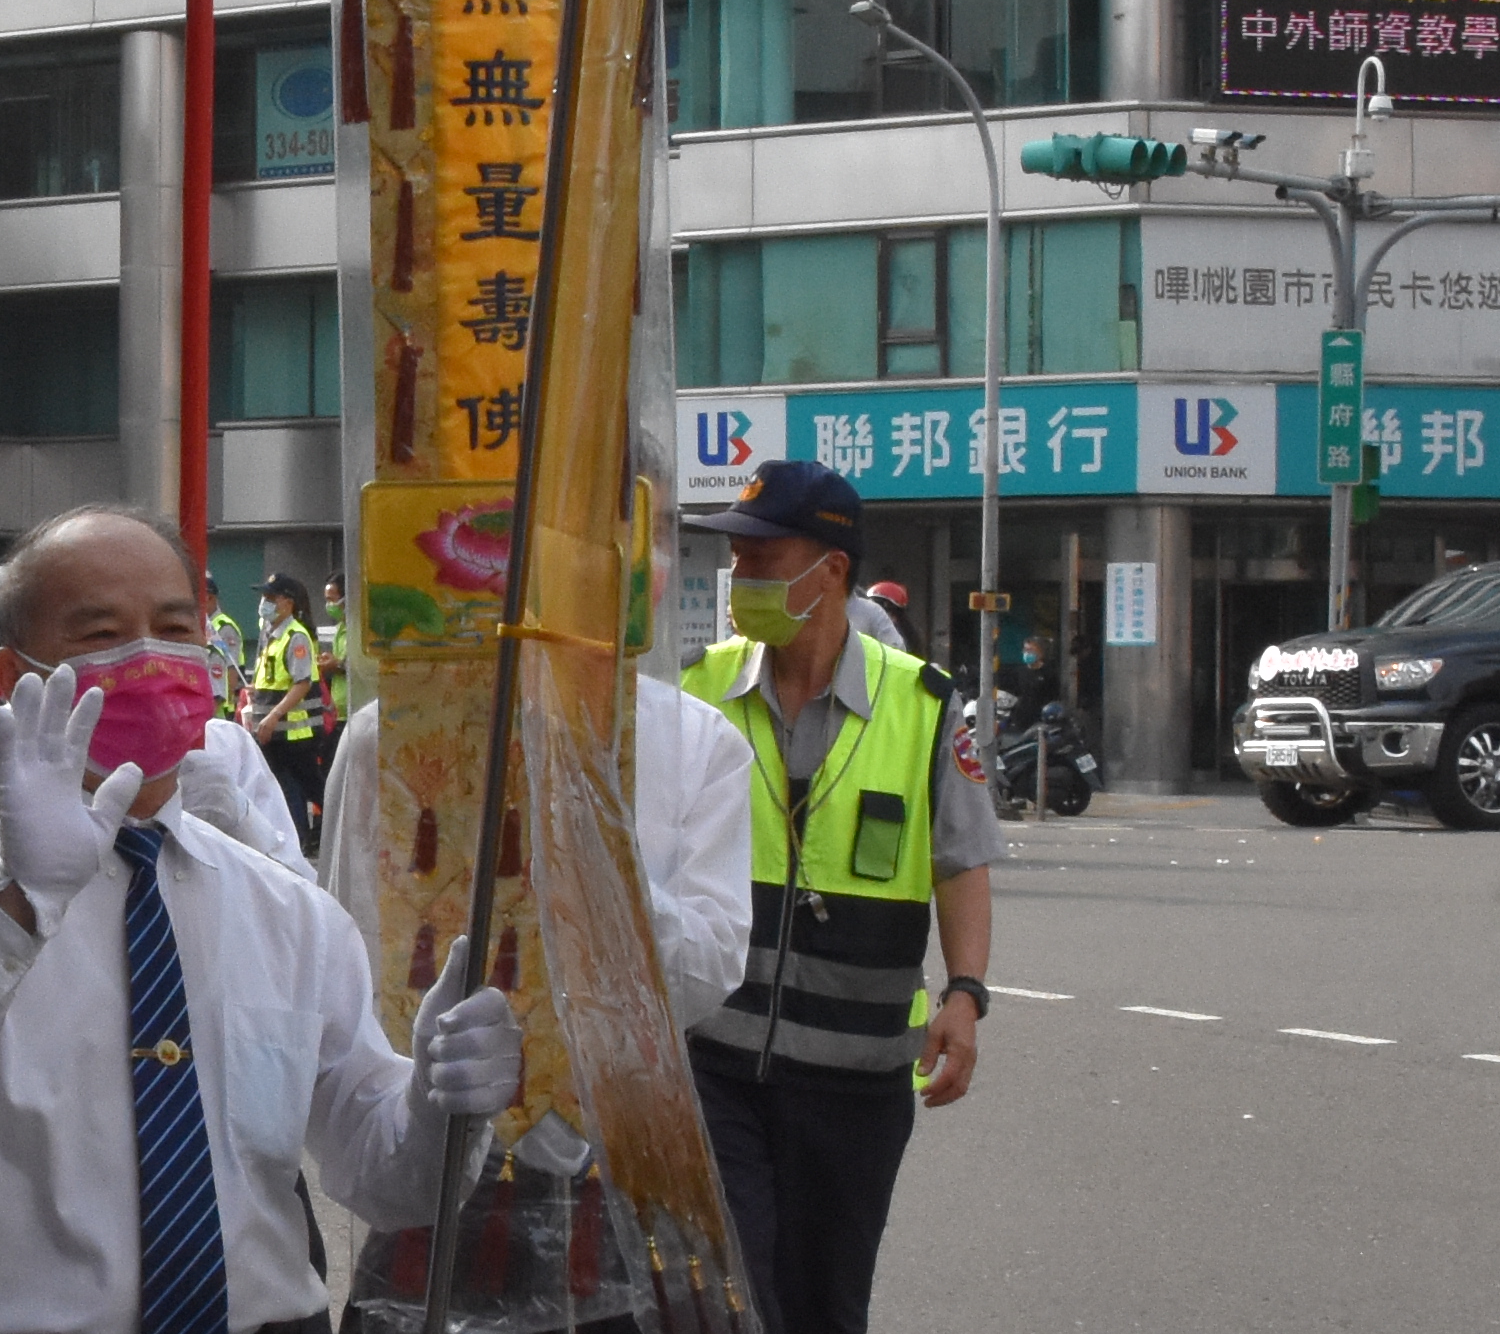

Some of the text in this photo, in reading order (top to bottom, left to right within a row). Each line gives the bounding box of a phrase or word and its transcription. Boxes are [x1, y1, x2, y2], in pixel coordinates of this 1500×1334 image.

[1241, 8, 1500, 60] 中外師資教學
[1327, 362, 1354, 470] 縣府路
[812, 405, 1109, 477] 聯邦銀行
[687, 475, 727, 489] UNION
[1163, 466, 1248, 480] UNION BANK
[1281, 673, 1330, 688] TOYOTA
